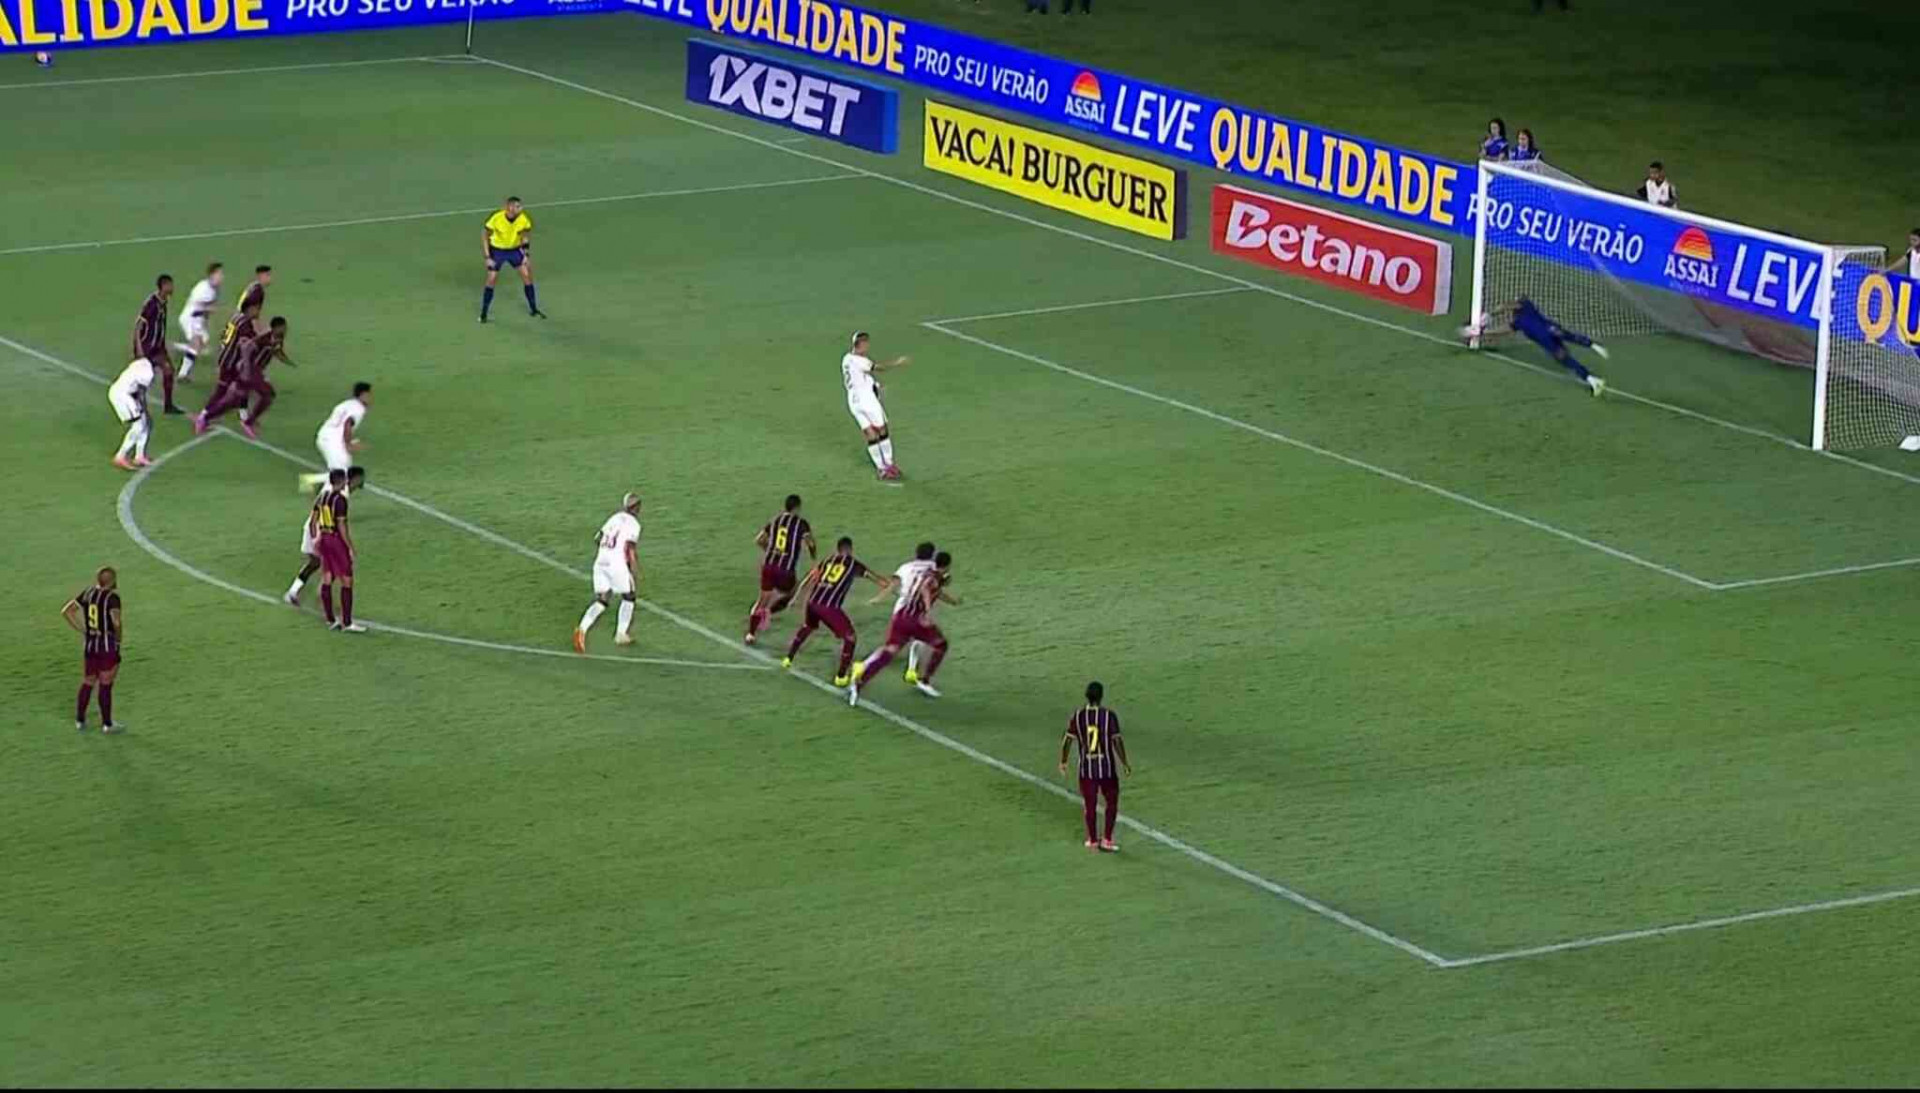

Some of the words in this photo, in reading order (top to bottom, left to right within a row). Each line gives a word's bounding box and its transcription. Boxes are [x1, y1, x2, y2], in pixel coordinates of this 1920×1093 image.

[706, 0, 906, 74] QUALIDADE
[914, 45, 951, 77] PRO
[953, 56, 988, 88] SEU
[993, 66, 1049, 104] VERÃO
[709, 54, 861, 136] 1XBET
[930, 115, 1015, 177] VACA!
[1022, 142, 1168, 223] BURGUER
[1112, 84, 1201, 152] LEVE
[1210, 107, 1458, 226] QUALIDADE
[1466, 193, 1514, 230] PRO
[1516, 206, 1562, 243] SEU
[1568, 217, 1644, 264] VERÃO
[1225, 199, 1422, 295] Betano
[776, 525, 788, 551] 6
[822, 562, 845, 585] 19
[88, 603, 98, 629] 9
[1087, 725, 1099, 752] 7
